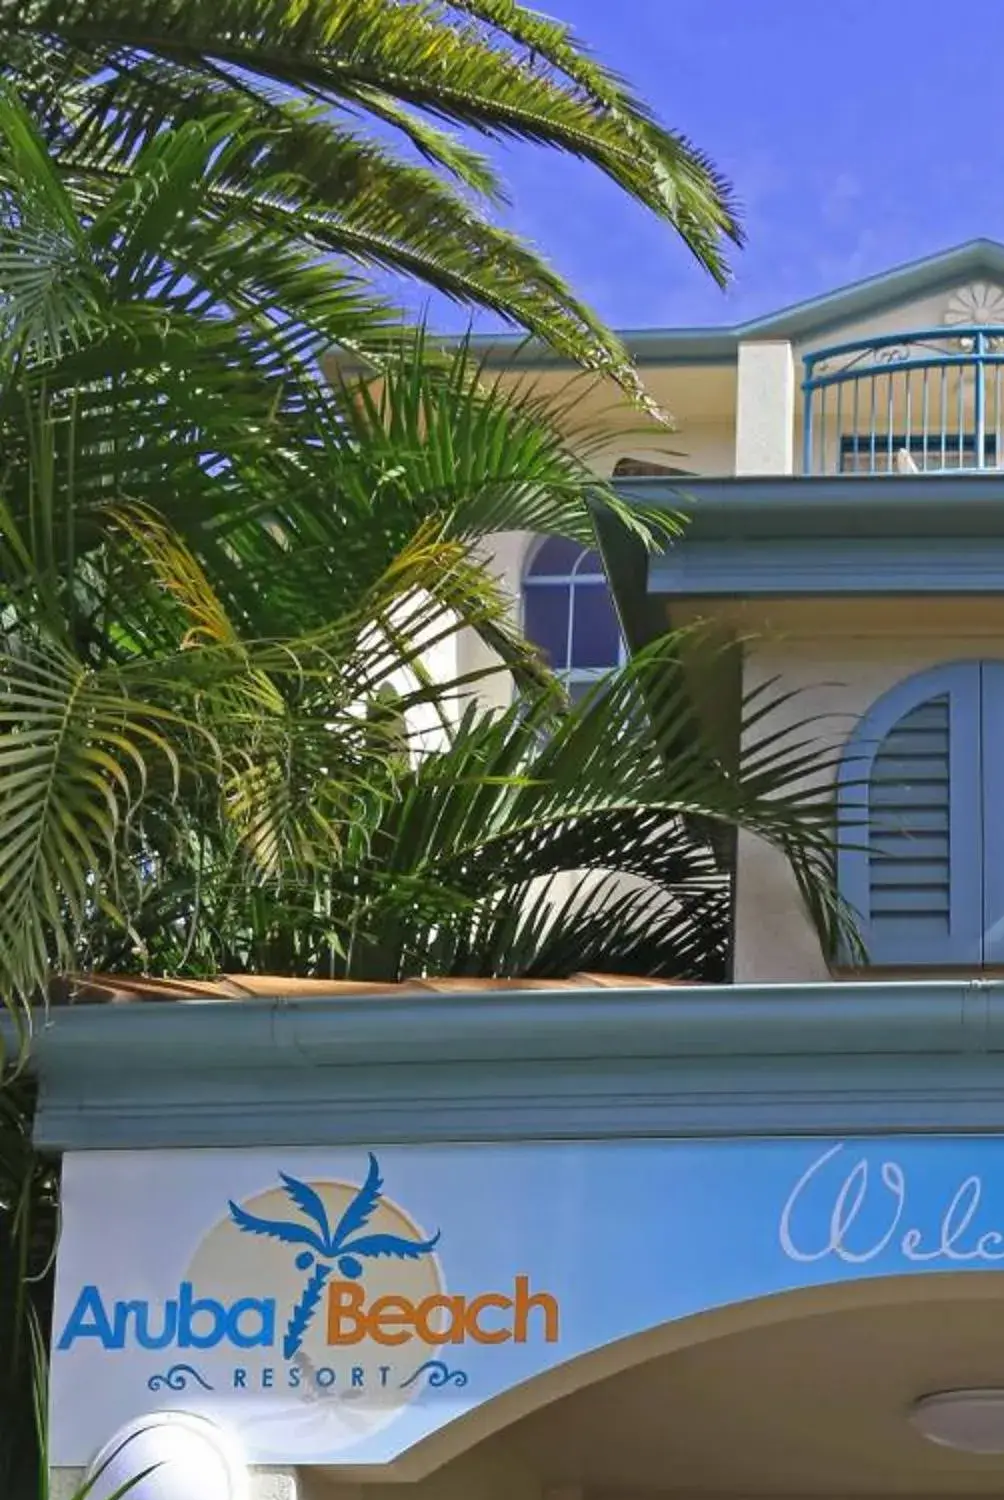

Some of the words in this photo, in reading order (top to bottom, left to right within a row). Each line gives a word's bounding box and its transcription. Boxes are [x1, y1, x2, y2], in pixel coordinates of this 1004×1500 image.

[57, 1281, 274, 1350] Aruba
[326, 1275, 560, 1346] Beach
[233, 1364, 392, 1389] RESORT
